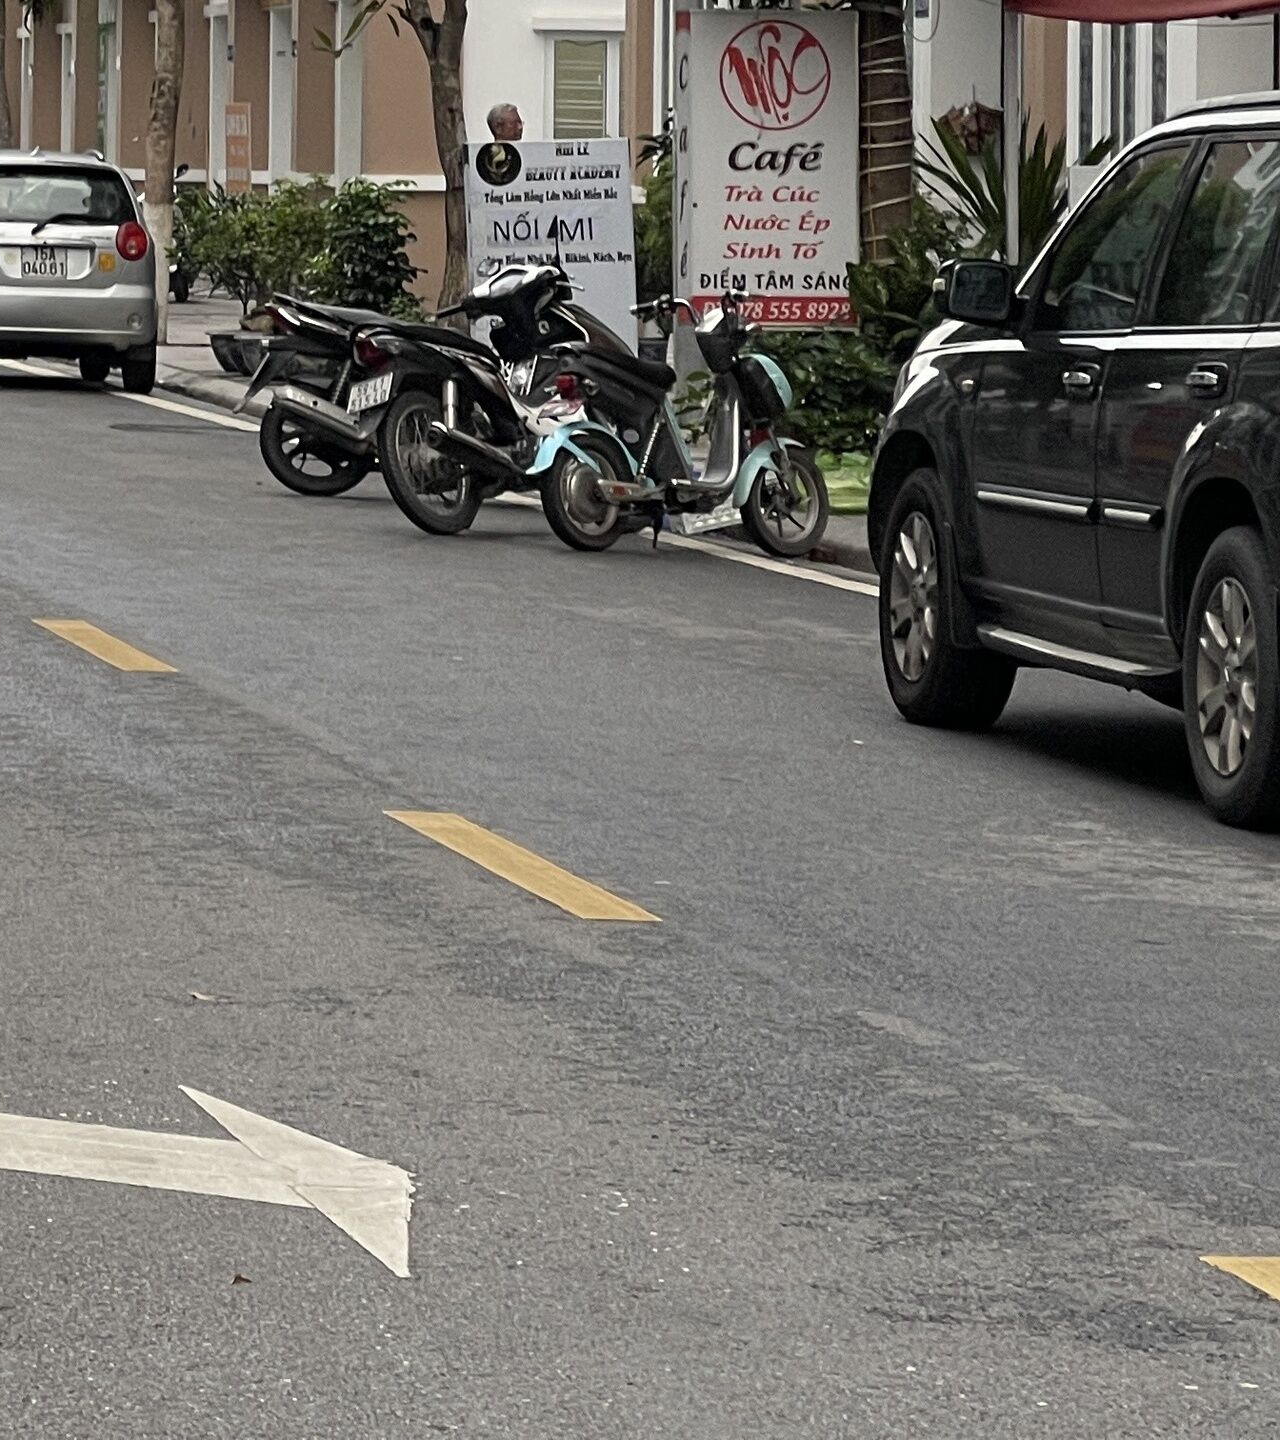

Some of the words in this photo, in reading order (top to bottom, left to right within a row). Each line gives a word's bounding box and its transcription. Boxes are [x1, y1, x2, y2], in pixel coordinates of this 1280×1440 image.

[728, 141, 824, 178] Café
[724, 185, 763, 202] Trà
[772, 185, 820, 202] Cúc
[493, 211, 539, 242] NỐI
[559, 217, 593, 242] MI
[798, 210, 831, 235] Ép
[722, 242, 781, 259] Sinh
[792, 240, 824, 259] Tố
[700, 266, 747, 291] ĐIỂM
[755, 270, 794, 290] TÂM
[768, 303, 801, 319] 555
